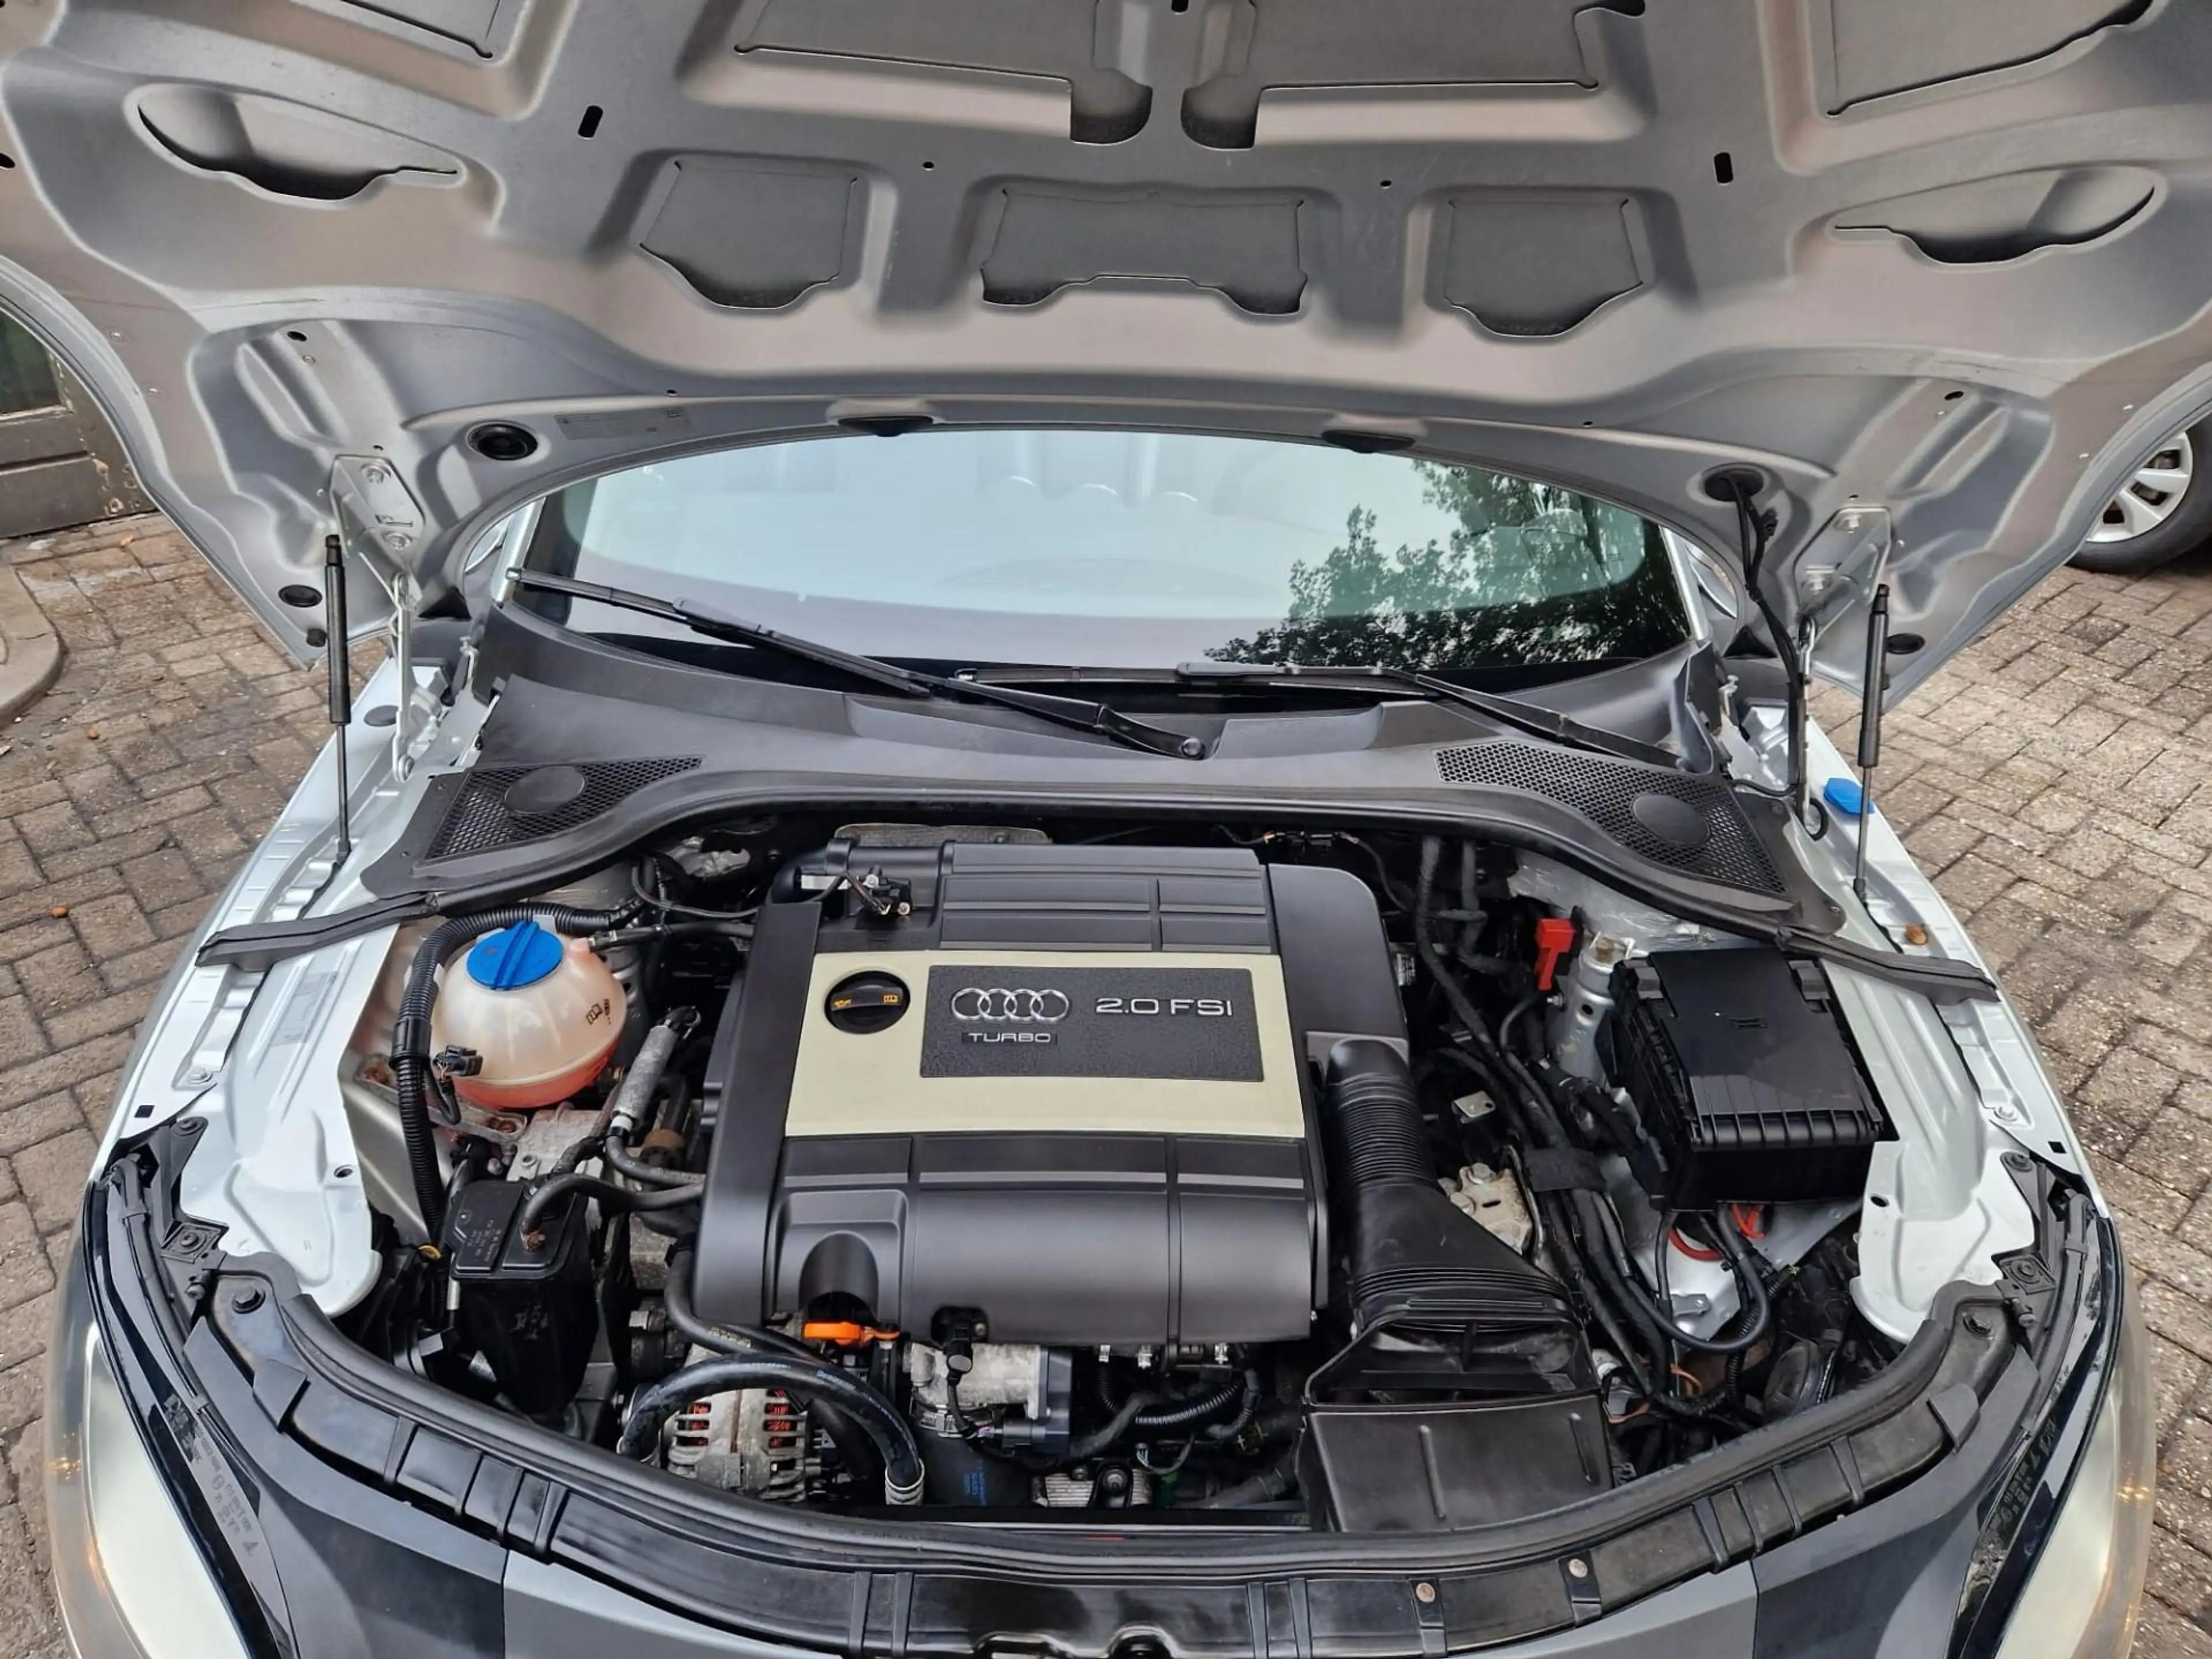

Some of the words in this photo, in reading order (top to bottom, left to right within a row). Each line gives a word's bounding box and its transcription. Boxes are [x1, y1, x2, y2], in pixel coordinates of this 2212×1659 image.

[1096, 998, 1159, 1014] 2.0
[1170, 999, 1233, 1016] FSI
[968, 1032, 1051, 1043] TURBO
